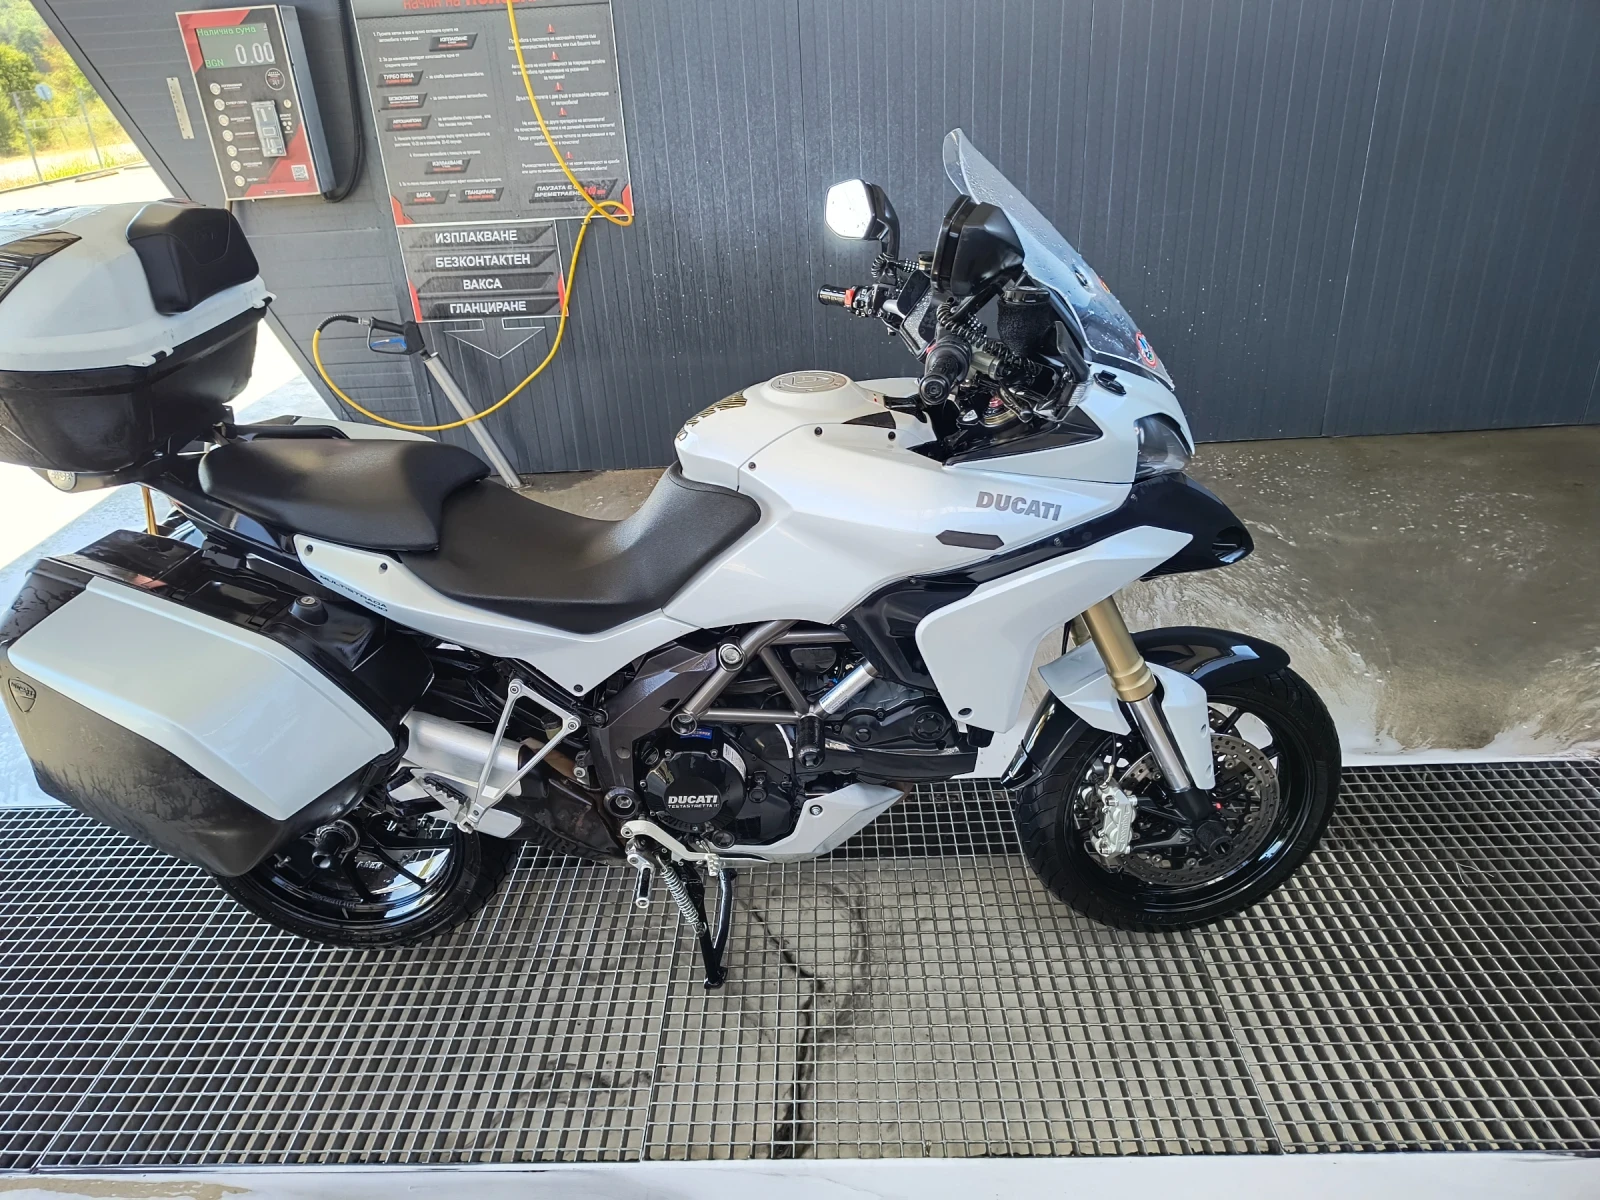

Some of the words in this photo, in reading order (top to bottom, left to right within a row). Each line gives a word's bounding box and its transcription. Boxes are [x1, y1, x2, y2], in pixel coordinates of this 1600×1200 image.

[197, 27, 234, 37] Налична
[235, 26, 257, 36] сума
[235, 42, 275, 65] 0.00
[205, 58, 225, 68] BGN
[434, 229, 518, 244] ИЗПЛАКВАНЕ
[435, 253, 531, 268] БЕЗКОНТАКТЕН
[463, 277, 503, 290] ВАКСА
[449, 300, 527, 315] ГЛАНЦИРАНЕ
[975, 490, 1063, 522] DUCATI
[668, 794, 719, 804] DUCATI
